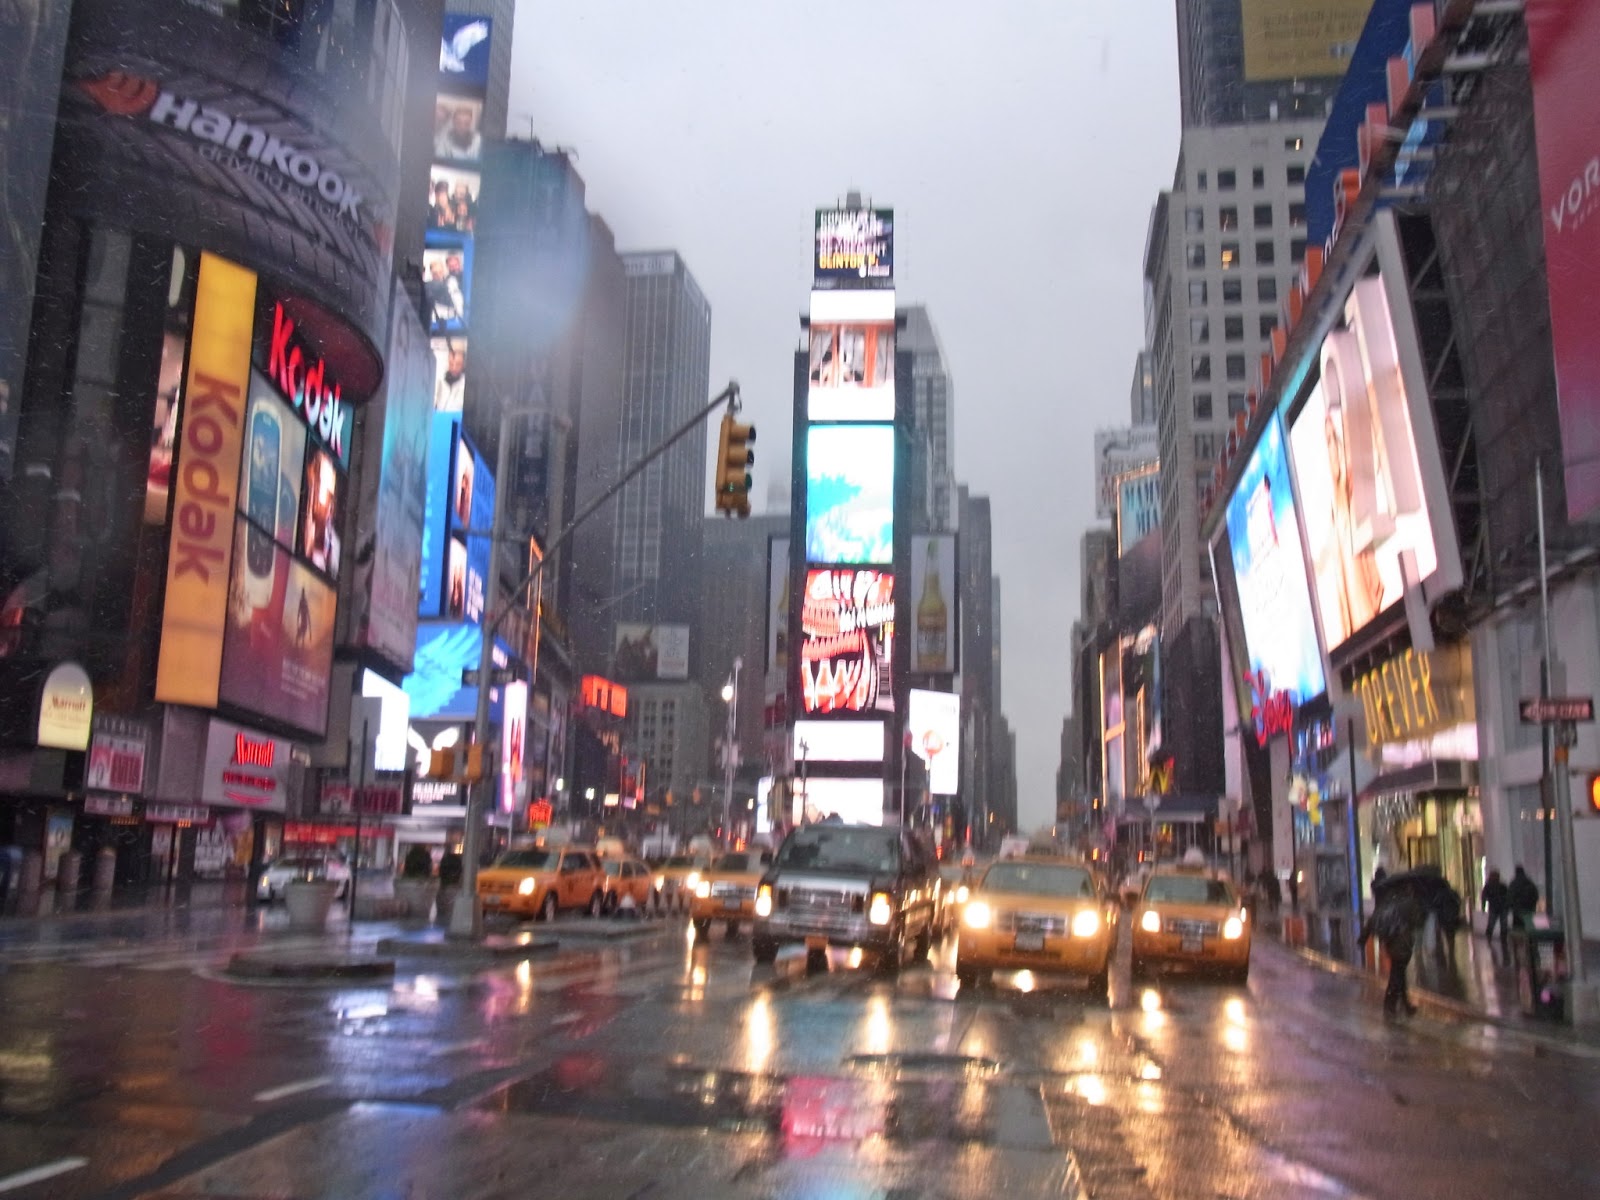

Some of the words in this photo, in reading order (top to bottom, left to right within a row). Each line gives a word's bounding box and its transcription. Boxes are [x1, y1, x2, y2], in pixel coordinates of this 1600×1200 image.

[150, 92, 361, 224] Hankook
[270, 300, 344, 458] Kodak
[174, 366, 241, 587] Kodak
[1352, 648, 1440, 745] OREVER
